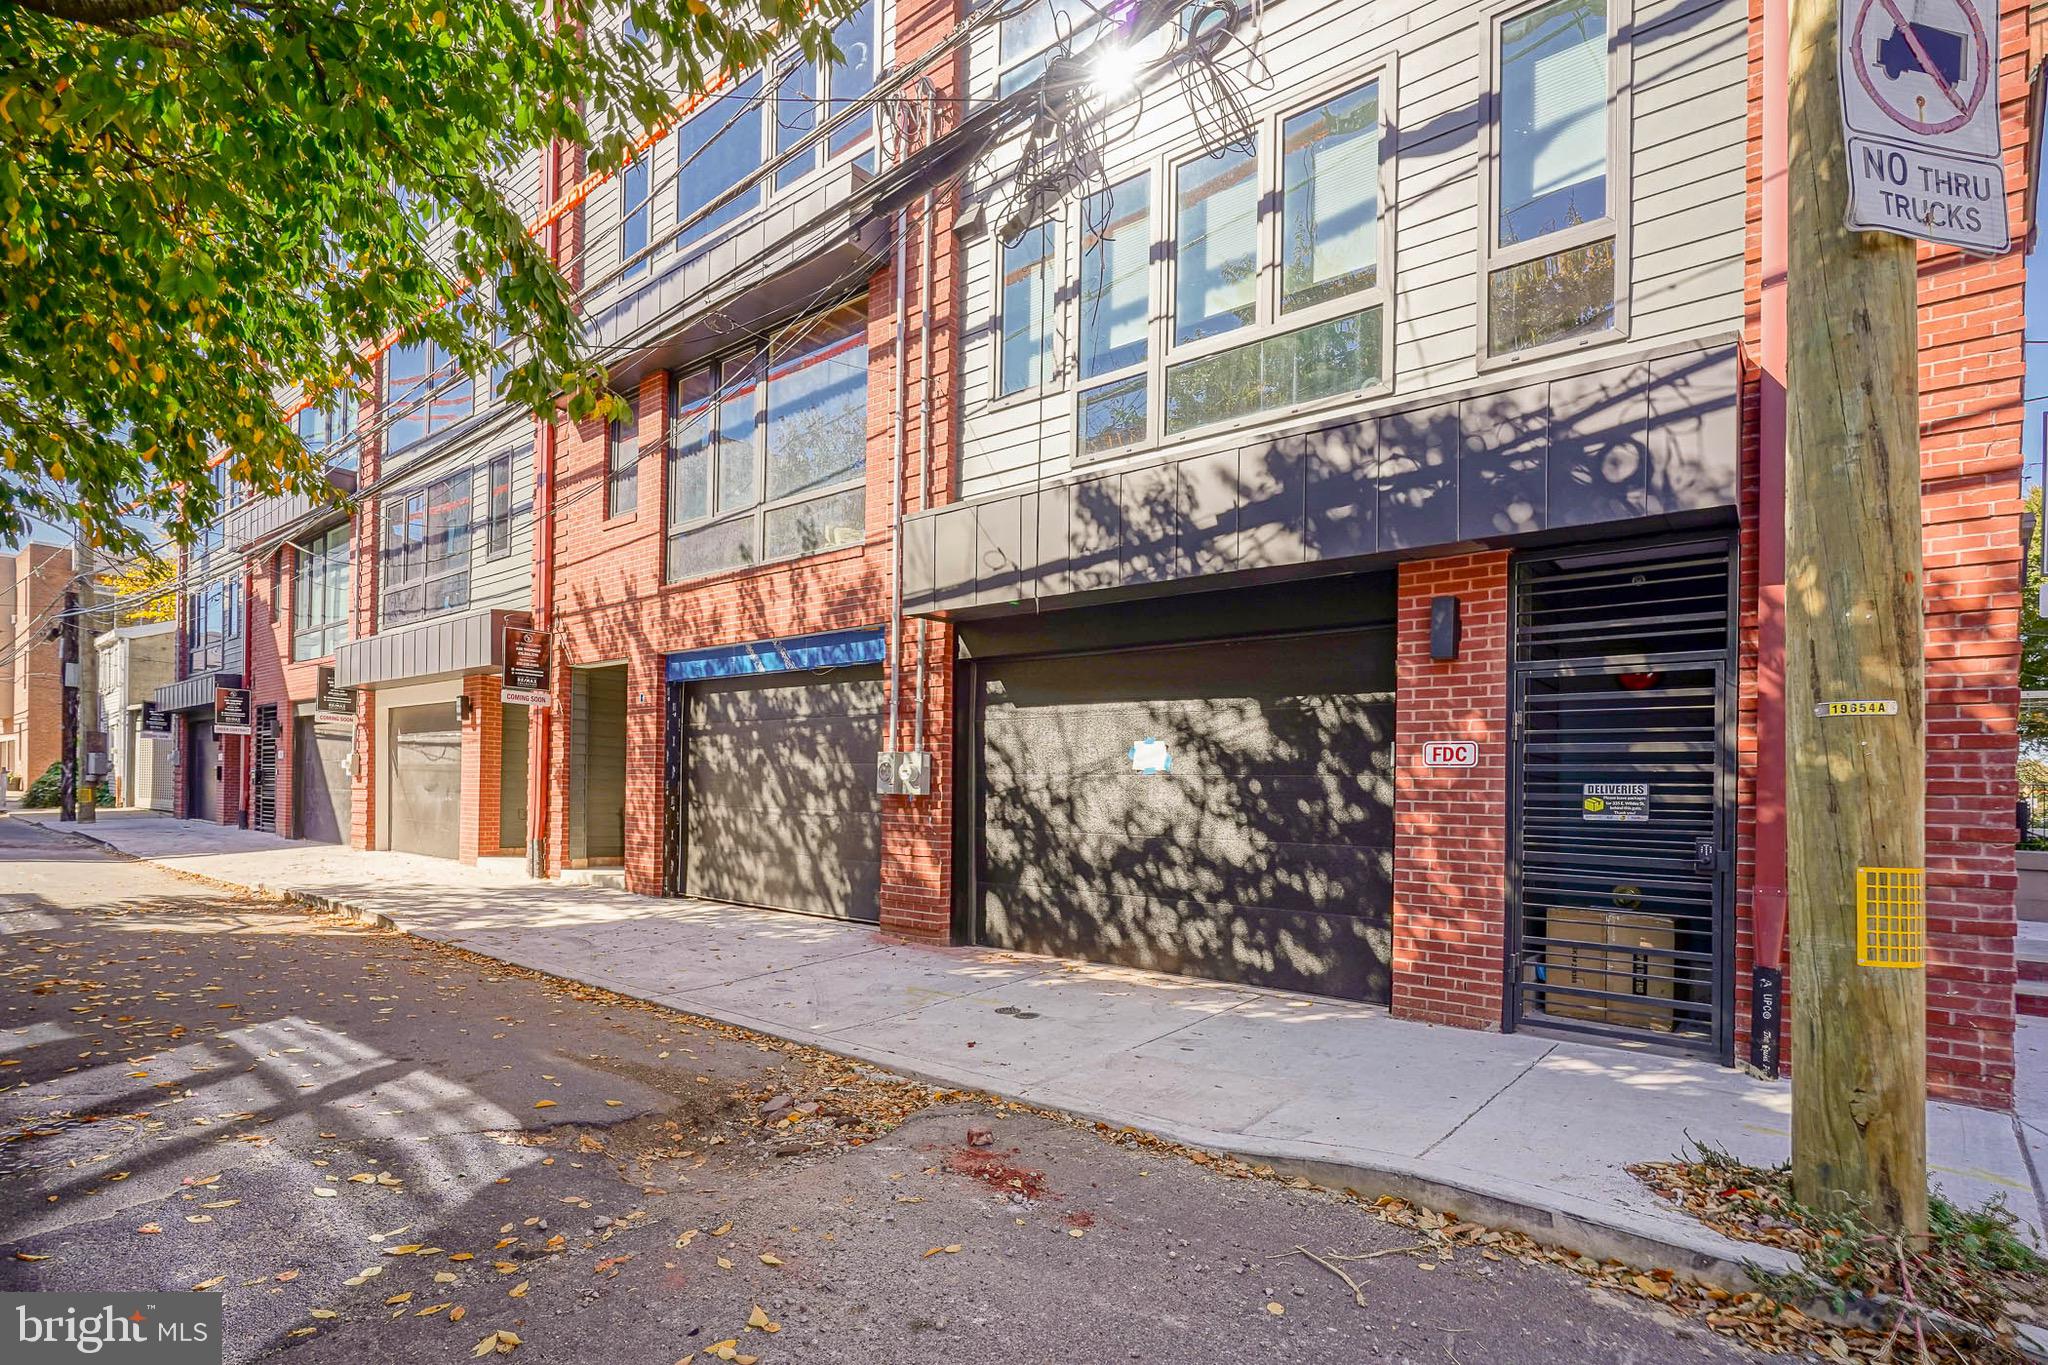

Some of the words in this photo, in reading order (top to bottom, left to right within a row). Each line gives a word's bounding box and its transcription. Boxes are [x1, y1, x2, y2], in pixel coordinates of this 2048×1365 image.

[1862, 146, 1908, 186] NO
[1917, 165, 1991, 201] THRU
[1879, 189, 1982, 232] TRUCKS
[506, 693, 530, 702] COMING
[530, 695, 546, 703] SOON
[1831, 703, 1885, 714] 19654A
[1433, 746, 1467, 762] FDC
[1588, 785, 1644, 794] DELIVERIES
